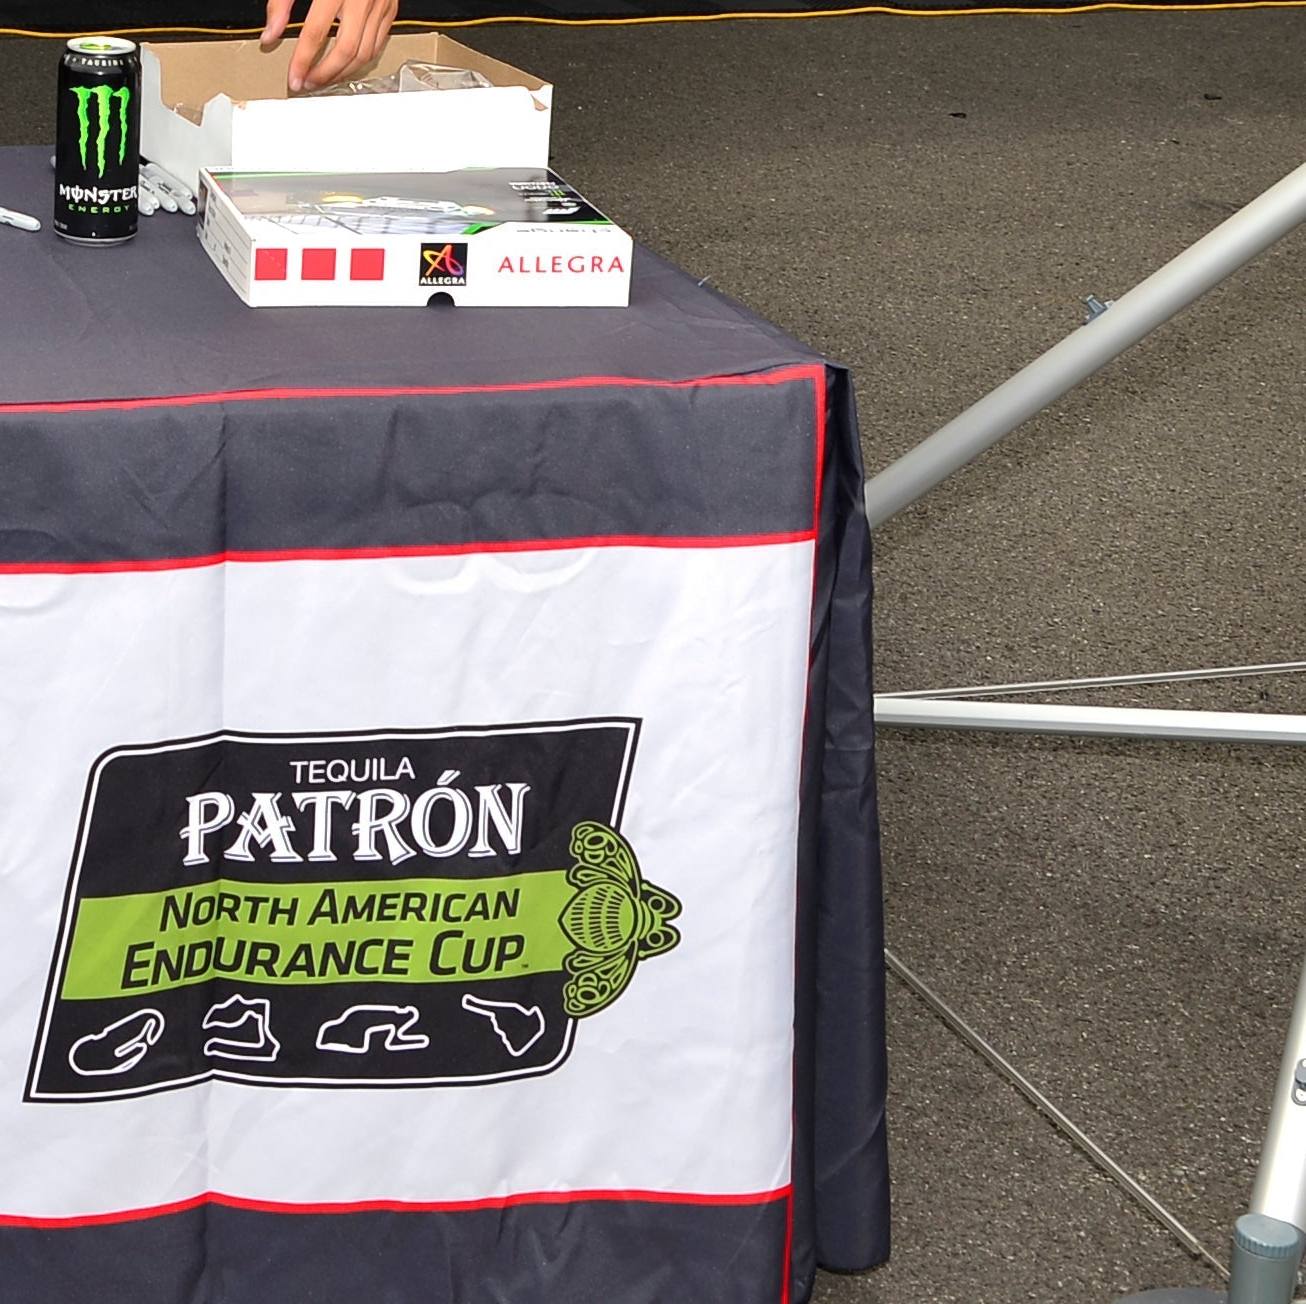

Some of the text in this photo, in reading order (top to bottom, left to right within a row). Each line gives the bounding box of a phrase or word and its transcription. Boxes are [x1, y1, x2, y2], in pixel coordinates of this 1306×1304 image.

[59, 183, 138, 205] MONSTER
[68, 204, 131, 214] ENERGY
[498, 254, 625, 274] ALLEGRA
[419, 275, 467, 286] ALLEGRA
[289, 756, 416, 785] TEQUILA
[179, 770, 531, 867] PATRÓN
[159, 886, 520, 933] NORTH AMERICAN
[120, 929, 524, 990] ENDURANCE CUP
